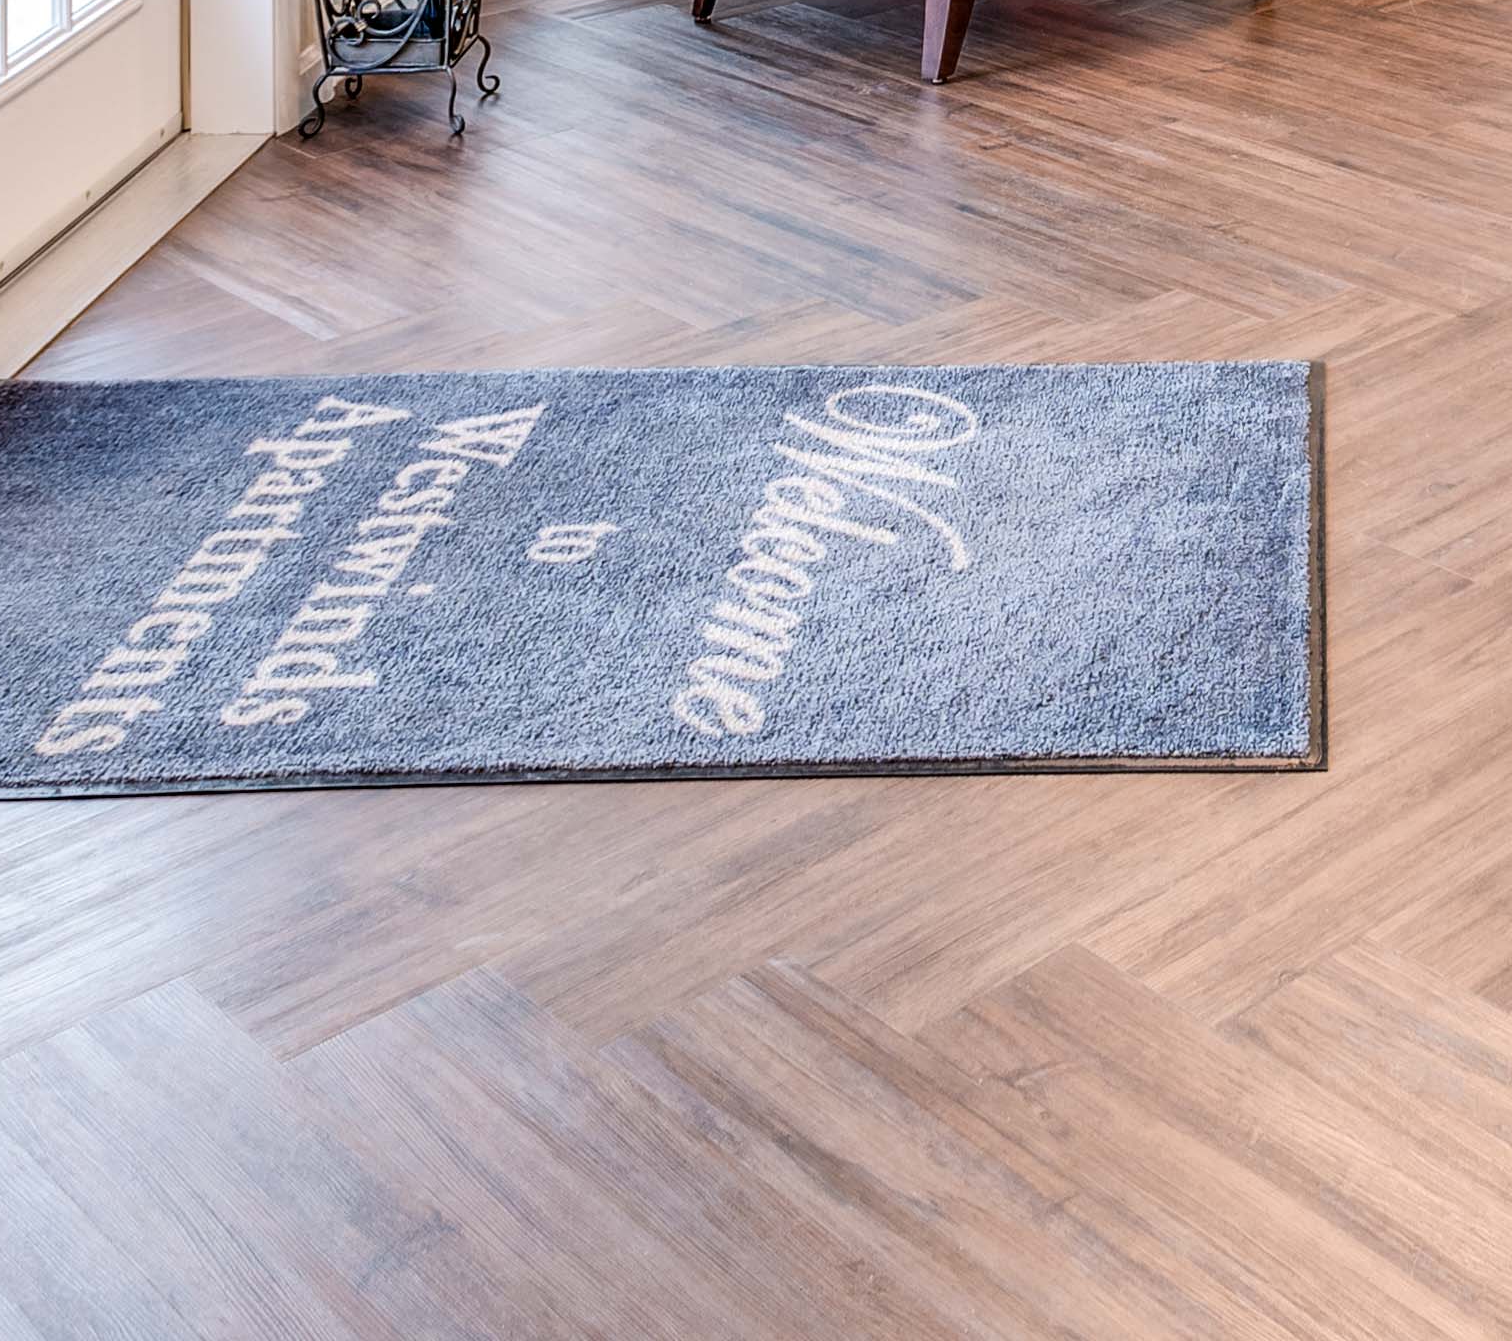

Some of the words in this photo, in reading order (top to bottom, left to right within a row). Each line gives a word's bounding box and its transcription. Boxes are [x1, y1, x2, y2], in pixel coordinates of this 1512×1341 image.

[35, 395, 415, 757] Apartments
[220, 401, 548, 729] Westwinds
[525, 520, 619, 566] to
[672, 384, 978, 739] Welcome
